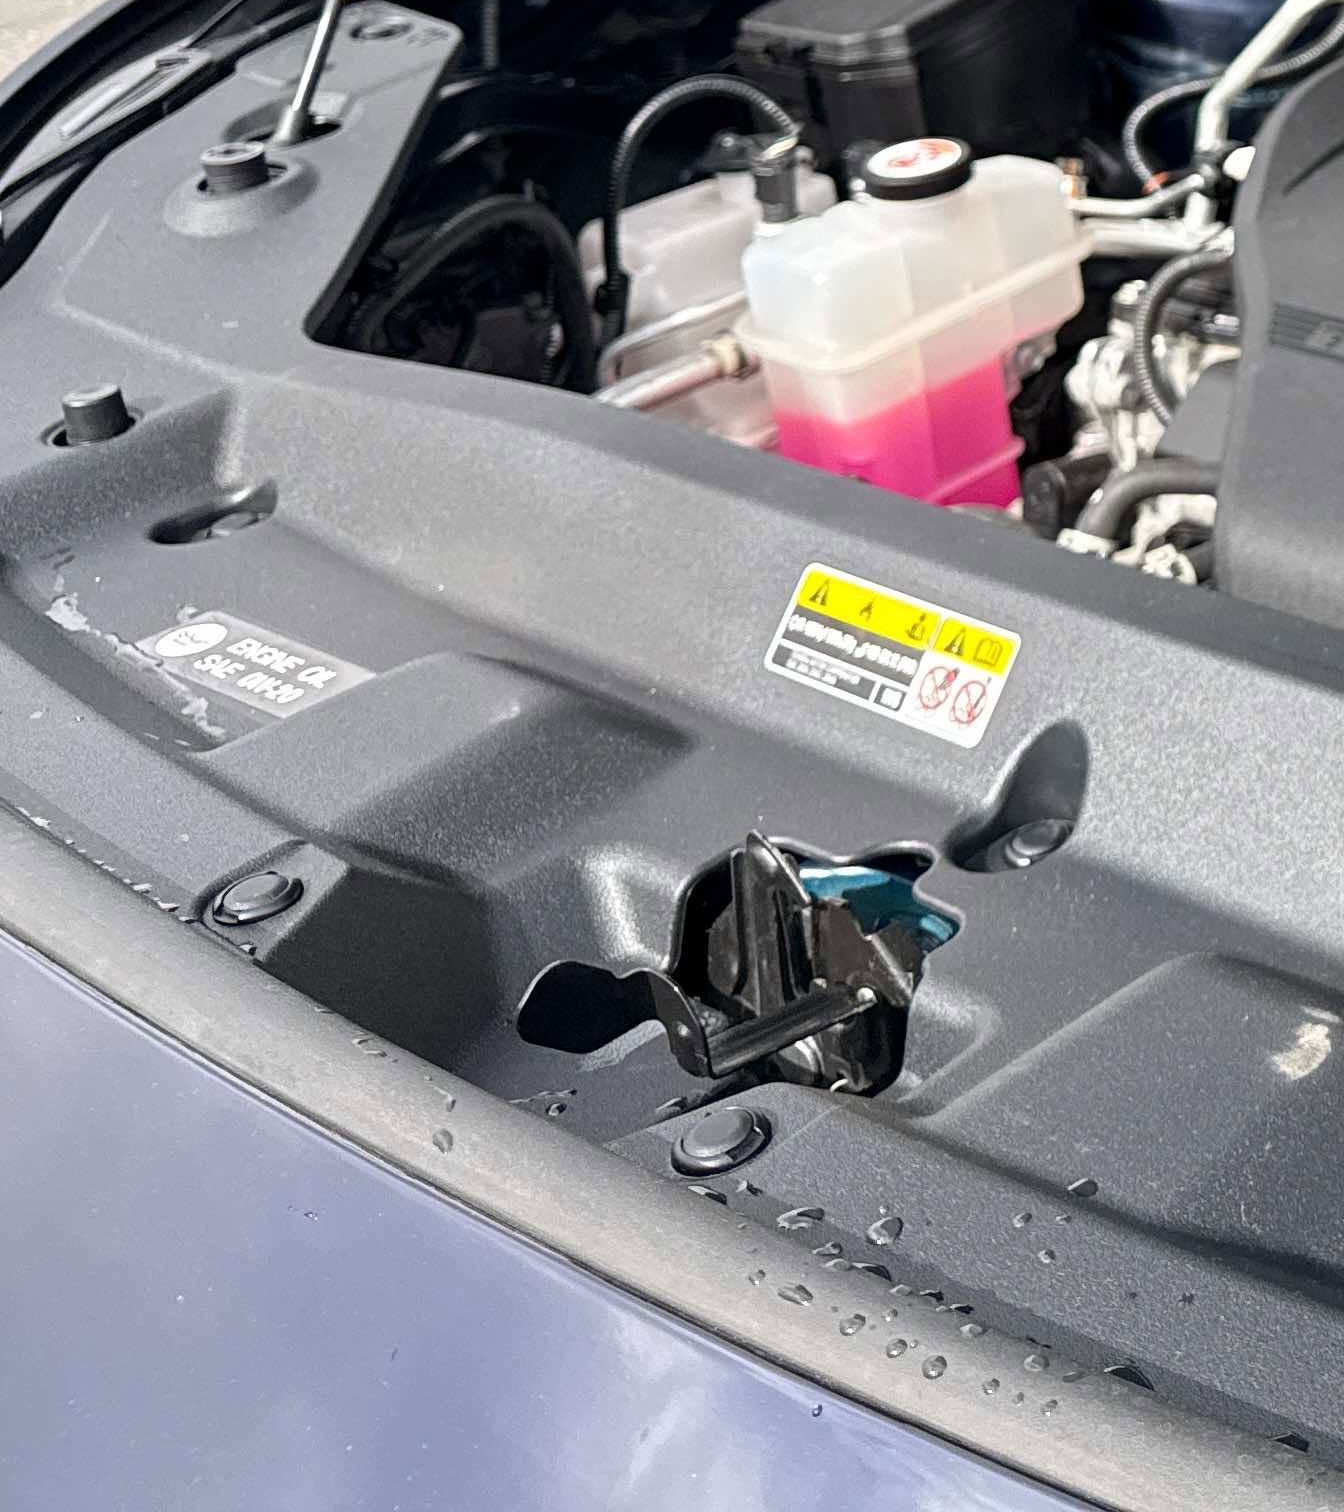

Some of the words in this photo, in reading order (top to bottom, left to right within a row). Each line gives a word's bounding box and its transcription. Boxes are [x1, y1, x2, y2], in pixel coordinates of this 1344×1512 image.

[193, 653, 246, 680] SAE
[225, 637, 306, 674] ENGINE
[296, 666, 337, 689] OIL
